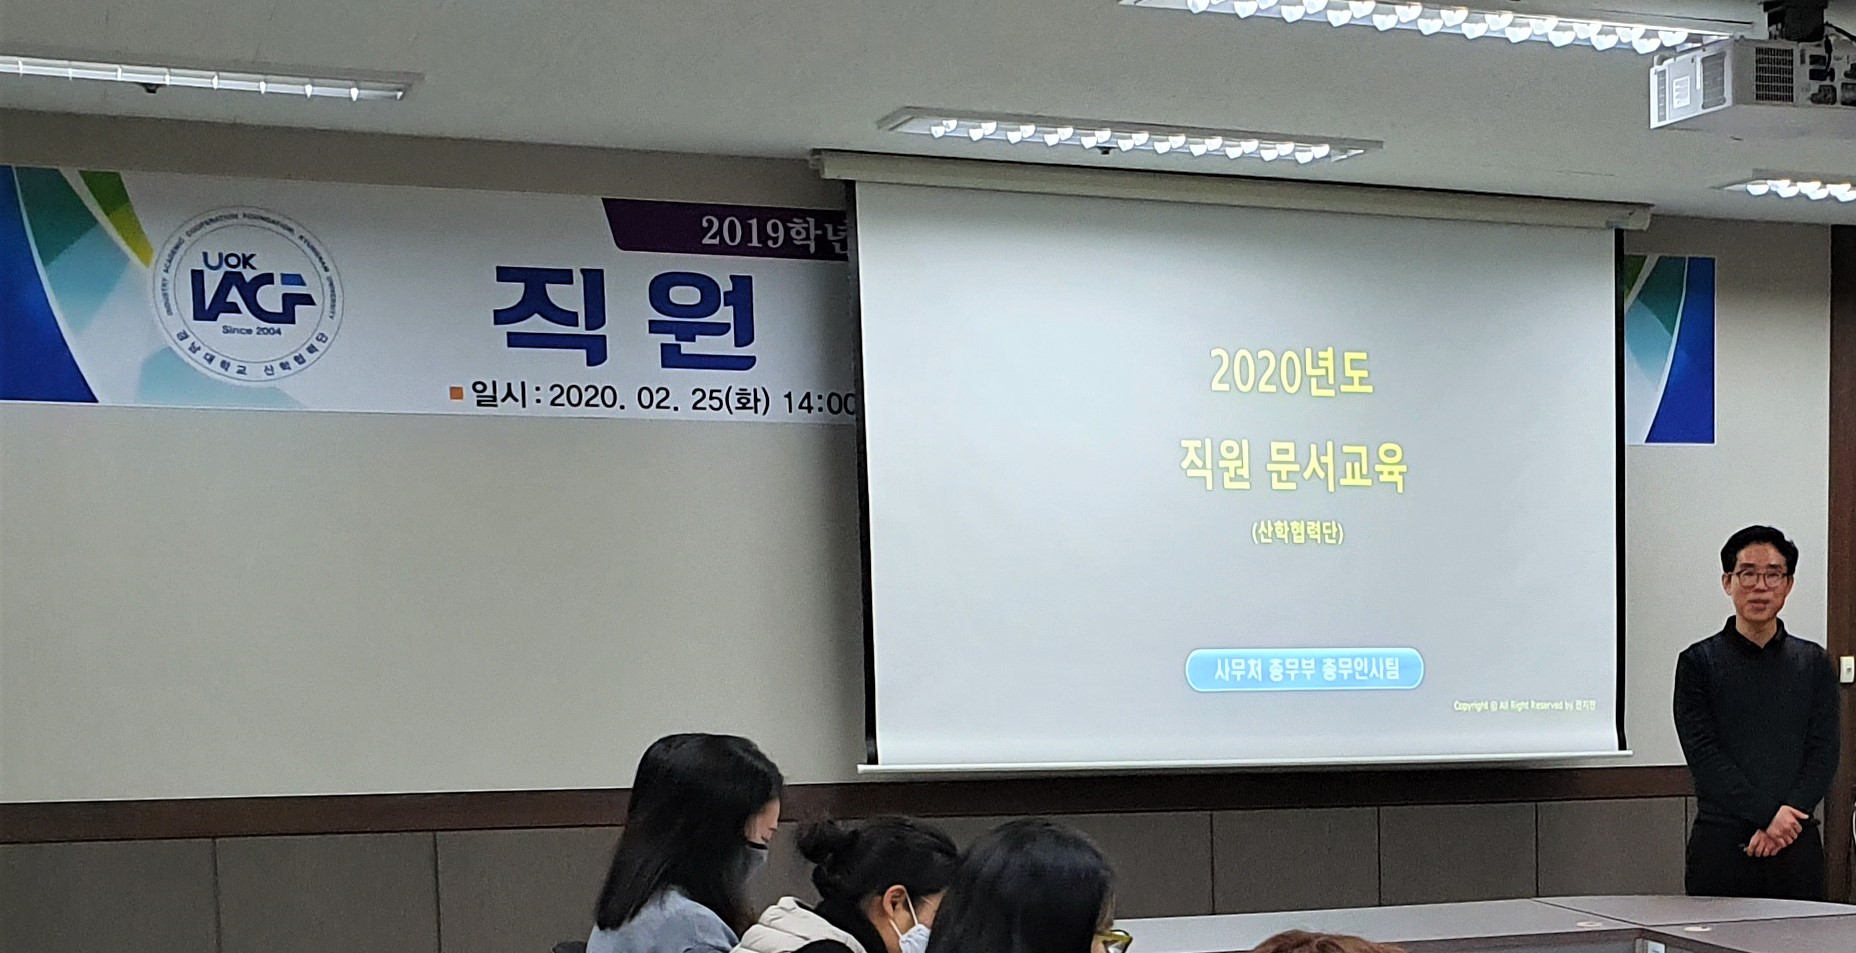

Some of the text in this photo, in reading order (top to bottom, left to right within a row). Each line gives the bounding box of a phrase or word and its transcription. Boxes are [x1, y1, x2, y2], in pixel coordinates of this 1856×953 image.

[202, 251, 257, 271] UOK
[222, 325, 282, 336] Since 2004
[1209, 346, 1374, 397] 2020년도
[637, 386, 679, 412] 02.
[691, 386, 770, 415] 25(화)
[1180, 437, 1408, 494] 직원 문서교육
[1251, 519, 1344, 544] (산학협력단)
[1453, 700, 1489, 712] Copyright
[1499, 700, 1509, 711] All
[1530, 700, 1563, 711] Reserved
